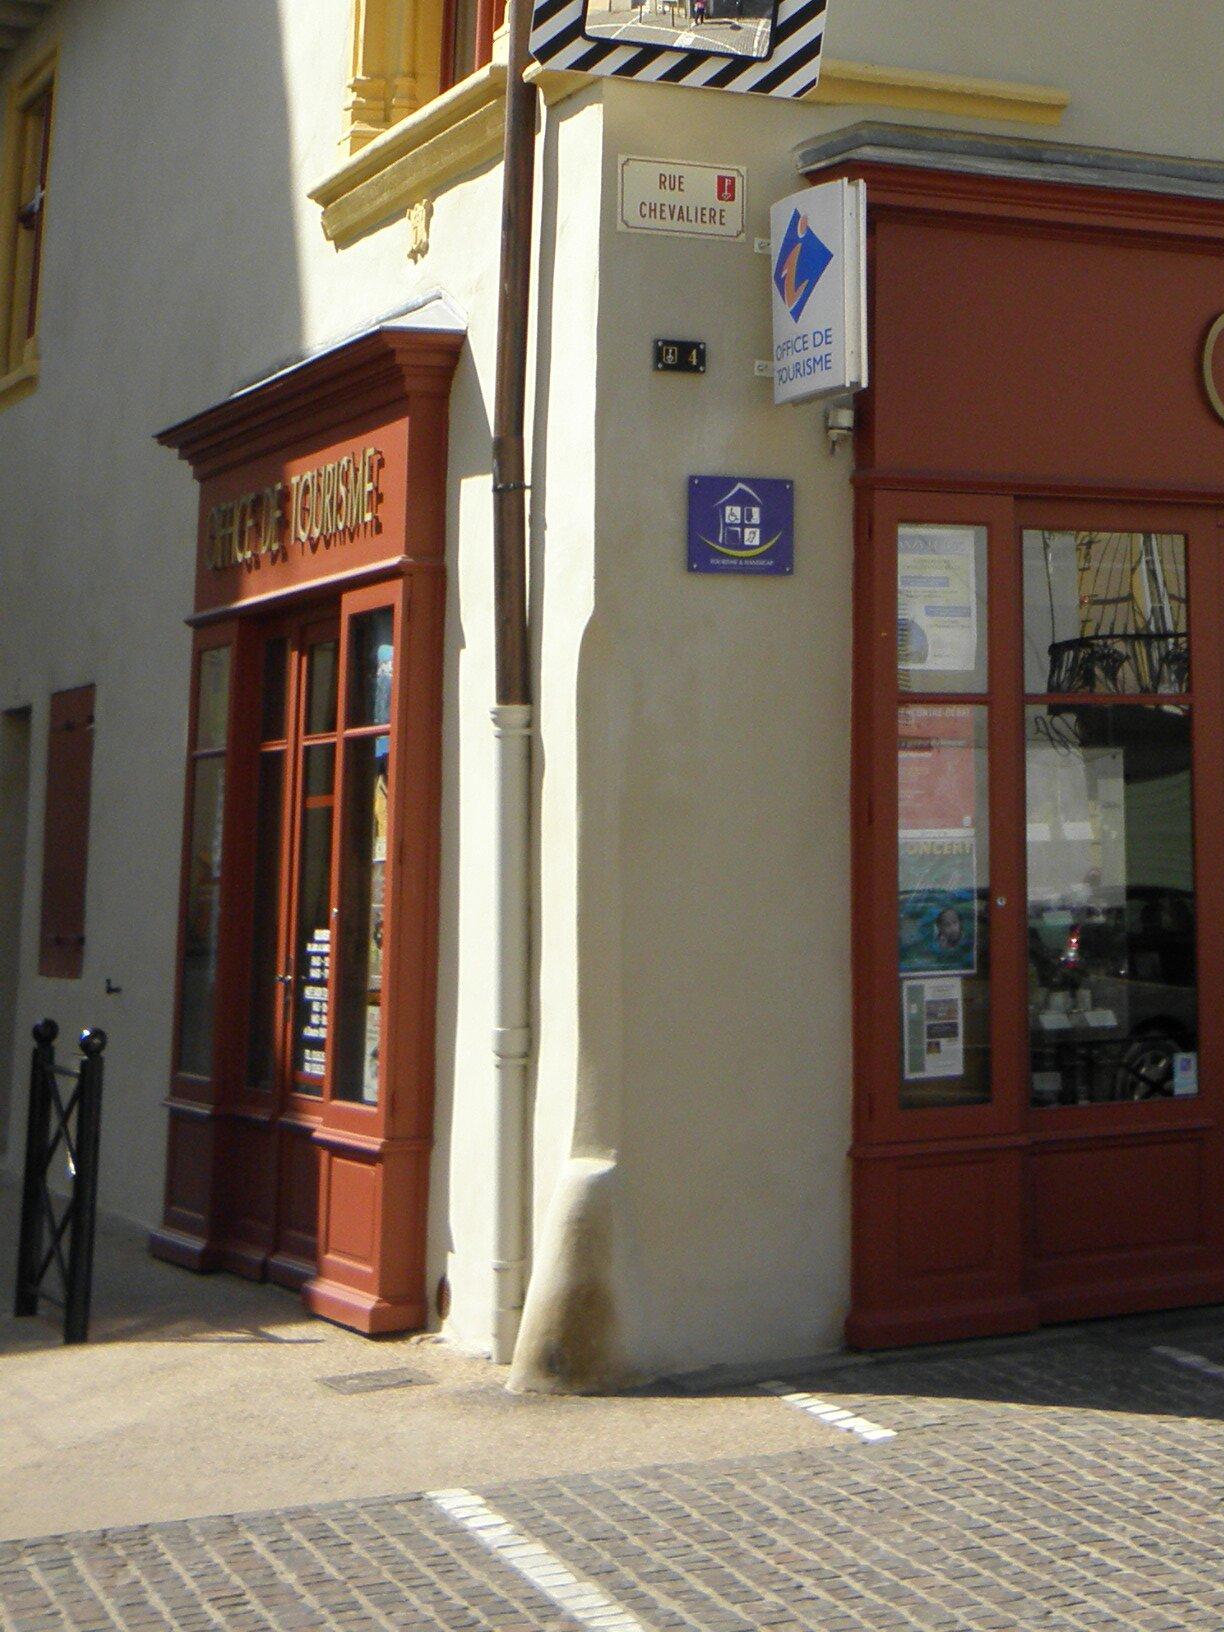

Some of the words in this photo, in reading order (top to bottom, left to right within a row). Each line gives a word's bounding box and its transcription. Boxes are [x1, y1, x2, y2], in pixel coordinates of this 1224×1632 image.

[658, 173, 686, 192] RUE
[639, 202, 726, 226] CHEVALIERE
[687, 349, 698, 366] 4
[775, 333, 809, 362] OFFICE
[812, 328, 833, 348] DE
[776, 353, 833, 385] TOURISME
[260, 482, 283, 554] DE
[290, 447, 376, 545] TOURISME
